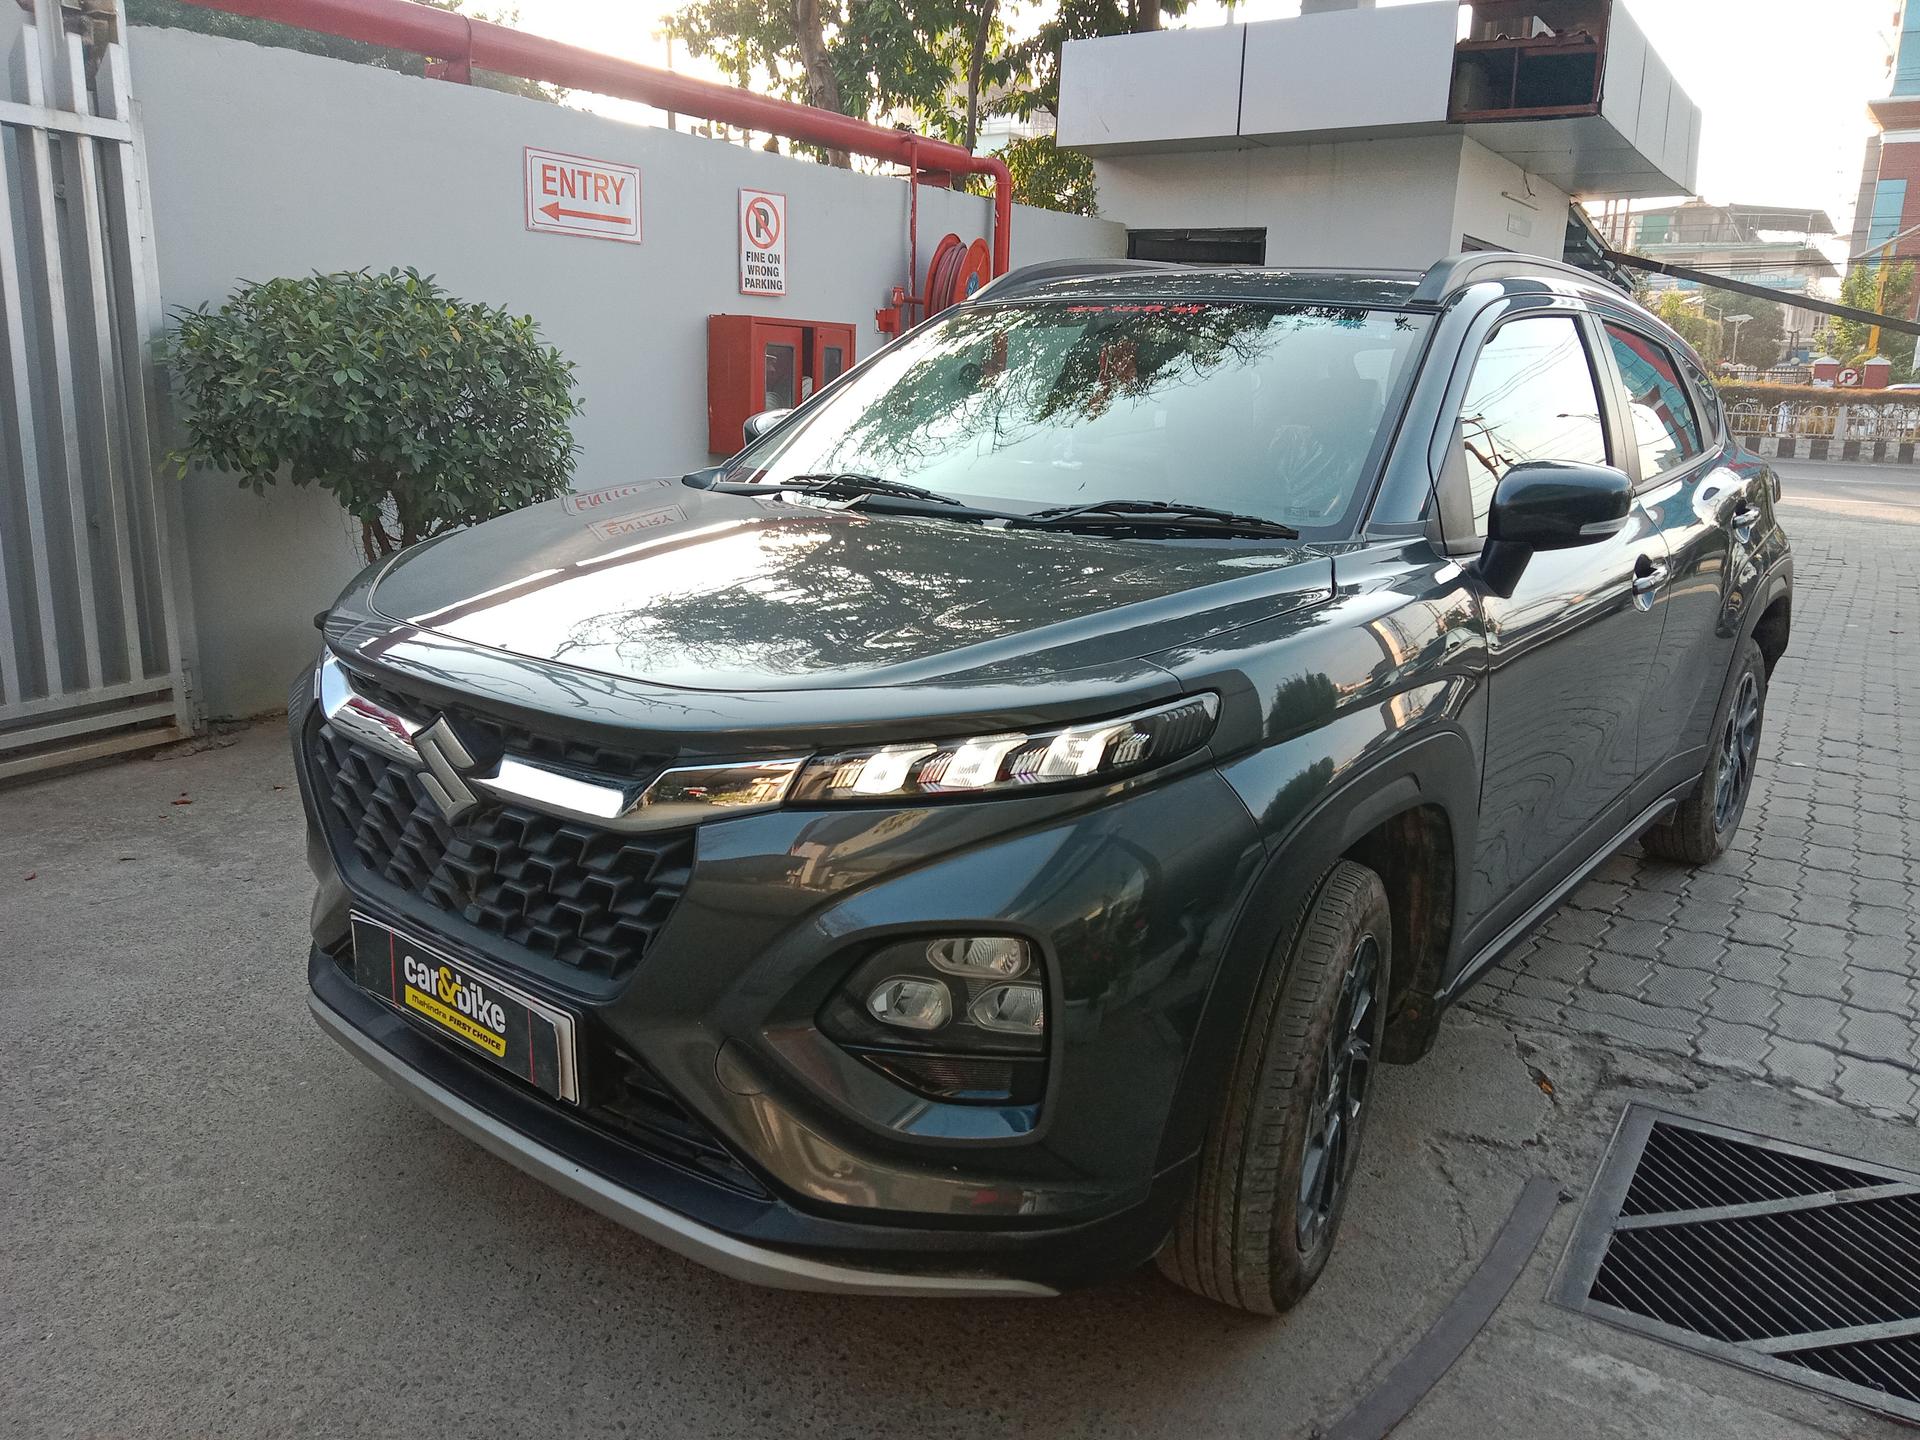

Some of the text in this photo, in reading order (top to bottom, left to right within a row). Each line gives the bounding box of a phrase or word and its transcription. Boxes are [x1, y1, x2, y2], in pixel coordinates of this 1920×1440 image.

[541, 163, 625, 206] ENTRY
[746, 251, 781, 264] FINE ON
[747, 264, 780, 277] WRONG
[744, 277, 783, 290] PARKING
[404, 955, 506, 1034] car&bike
[411, 994, 502, 1052] mahindra FIRST CHOICE
